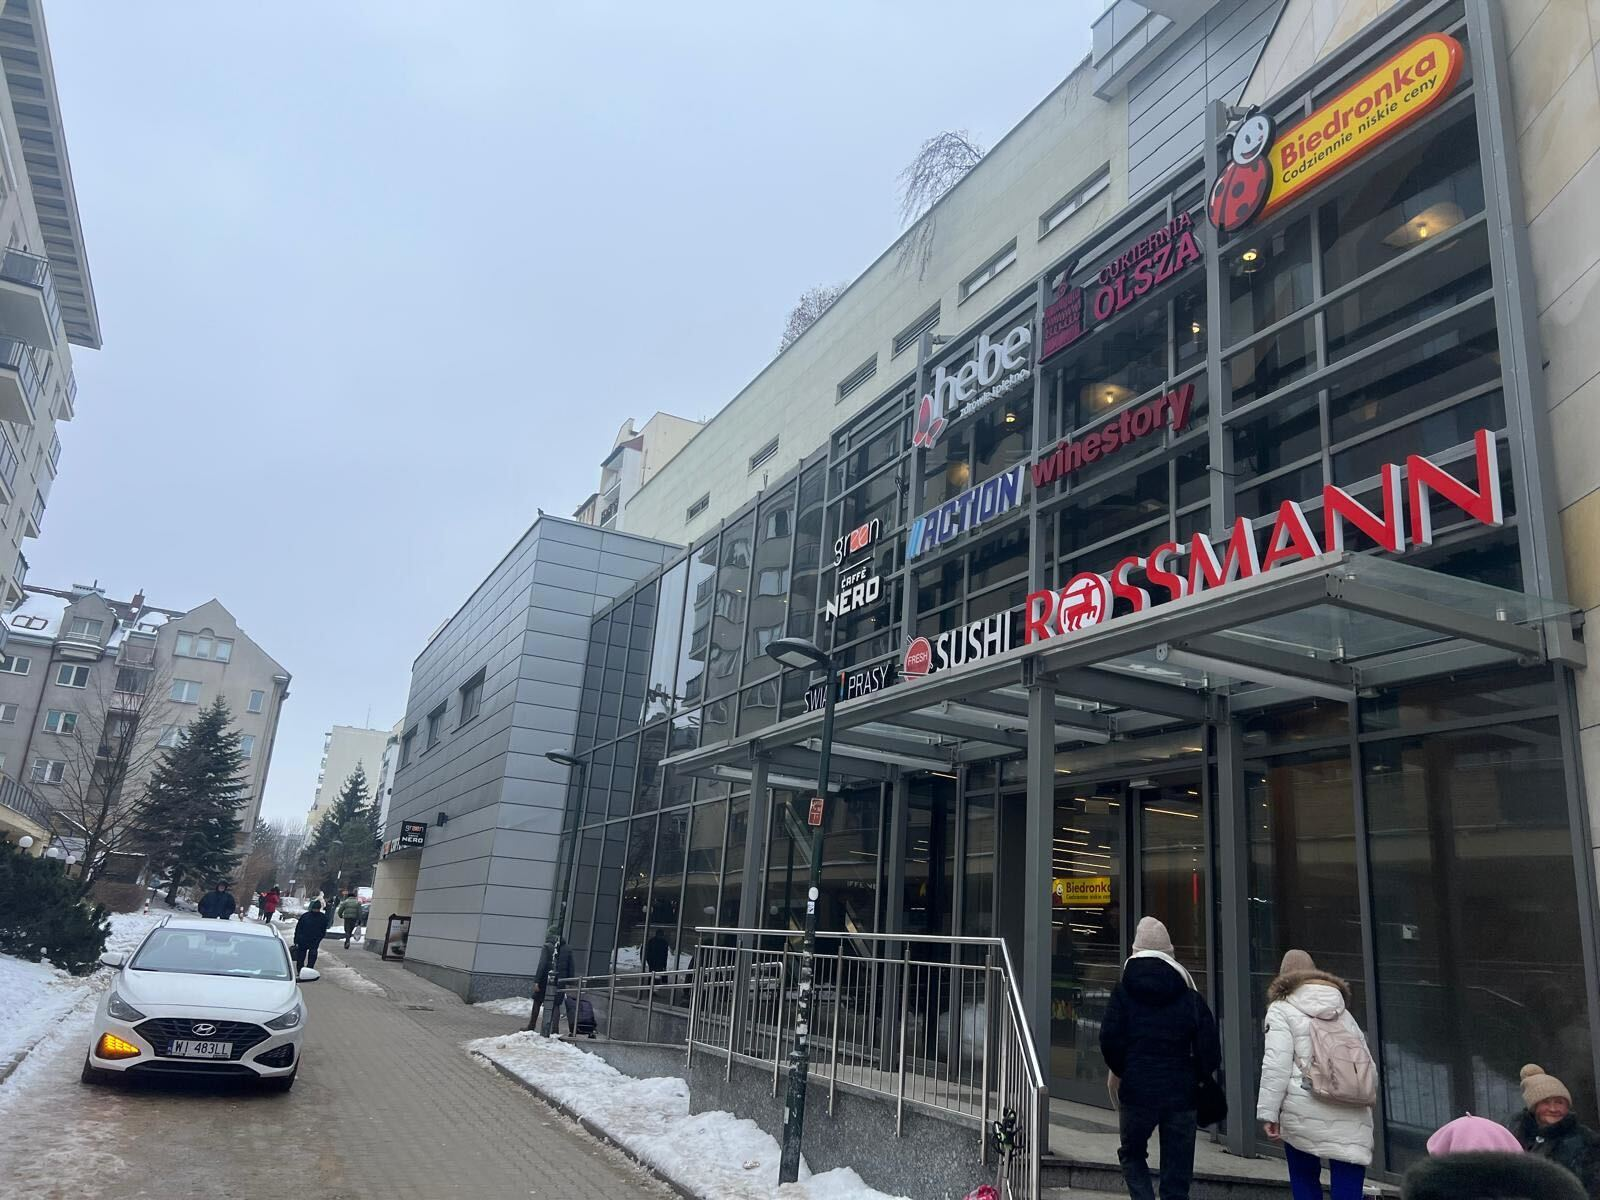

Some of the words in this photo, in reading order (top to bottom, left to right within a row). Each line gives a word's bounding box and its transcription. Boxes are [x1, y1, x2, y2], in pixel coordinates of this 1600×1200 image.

[1280, 51, 1437, 171] Biedronka
[1282, 132, 1353, 184] Codziennie
[1358, 100, 1398, 135] niskie
[1404, 75, 1438, 103] ceny
[1093, 231, 1200, 320] OLSZA
[1098, 210, 1194, 285] CUKIERNIA
[933, 326, 1031, 420] hebe
[1031, 383, 1195, 488] winestory
[919, 465, 1026, 551] ACTION
[1024, 428, 1503, 646] ROSSMANN
[825, 575, 881, 622] NERO
[907, 652, 928, 666] FRESH
[936, 610, 1011, 672] SUSHI
[802, 685, 828, 714] ŚWIA
[847, 664, 890, 700] PRASY
[401, 836, 424, 844] NERO
[194, 1042, 228, 1055] 483LL
